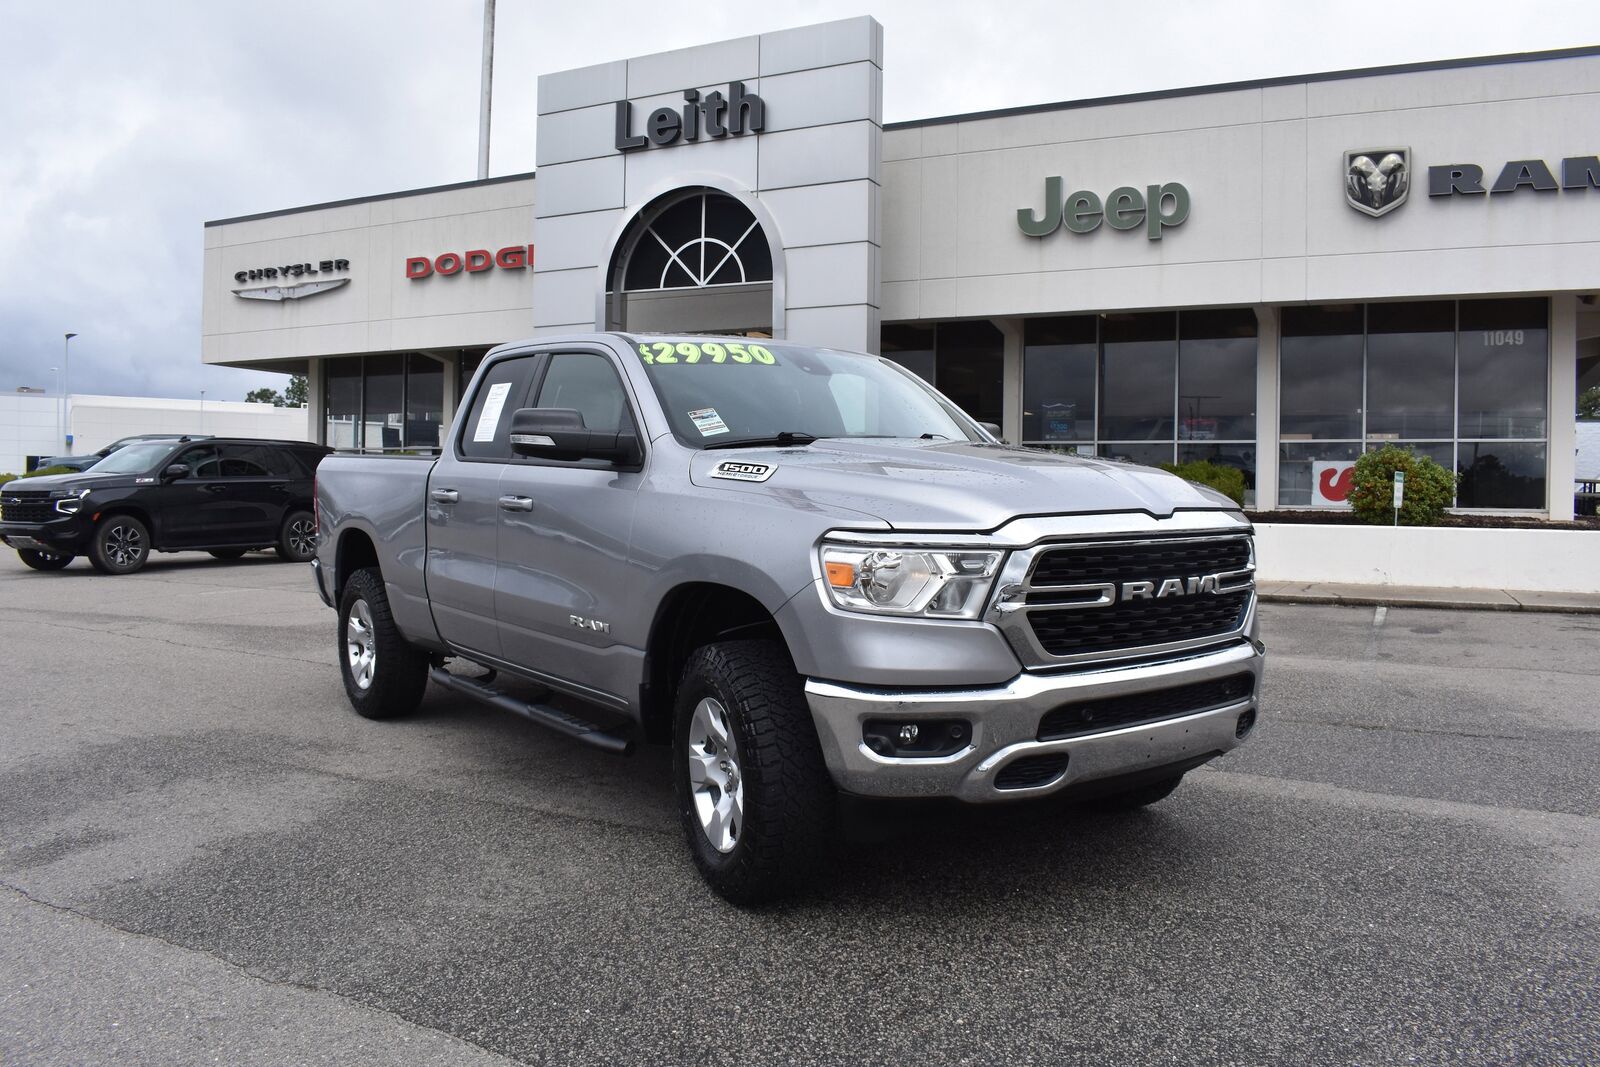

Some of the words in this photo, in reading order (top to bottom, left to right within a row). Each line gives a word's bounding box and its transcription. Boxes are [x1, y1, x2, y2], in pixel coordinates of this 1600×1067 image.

[615, 80, 766, 152] Leith
[1016, 175, 1191, 240] Jeep
[234, 258, 350, 282] CHRYSLER
[406, 244, 534, 279] DODG
[1483, 330, 1524, 346] 11049
[639, 342, 776, 365] $29950
[723, 463, 766, 474] 1500
[1121, 574, 1214, 601] RAM
